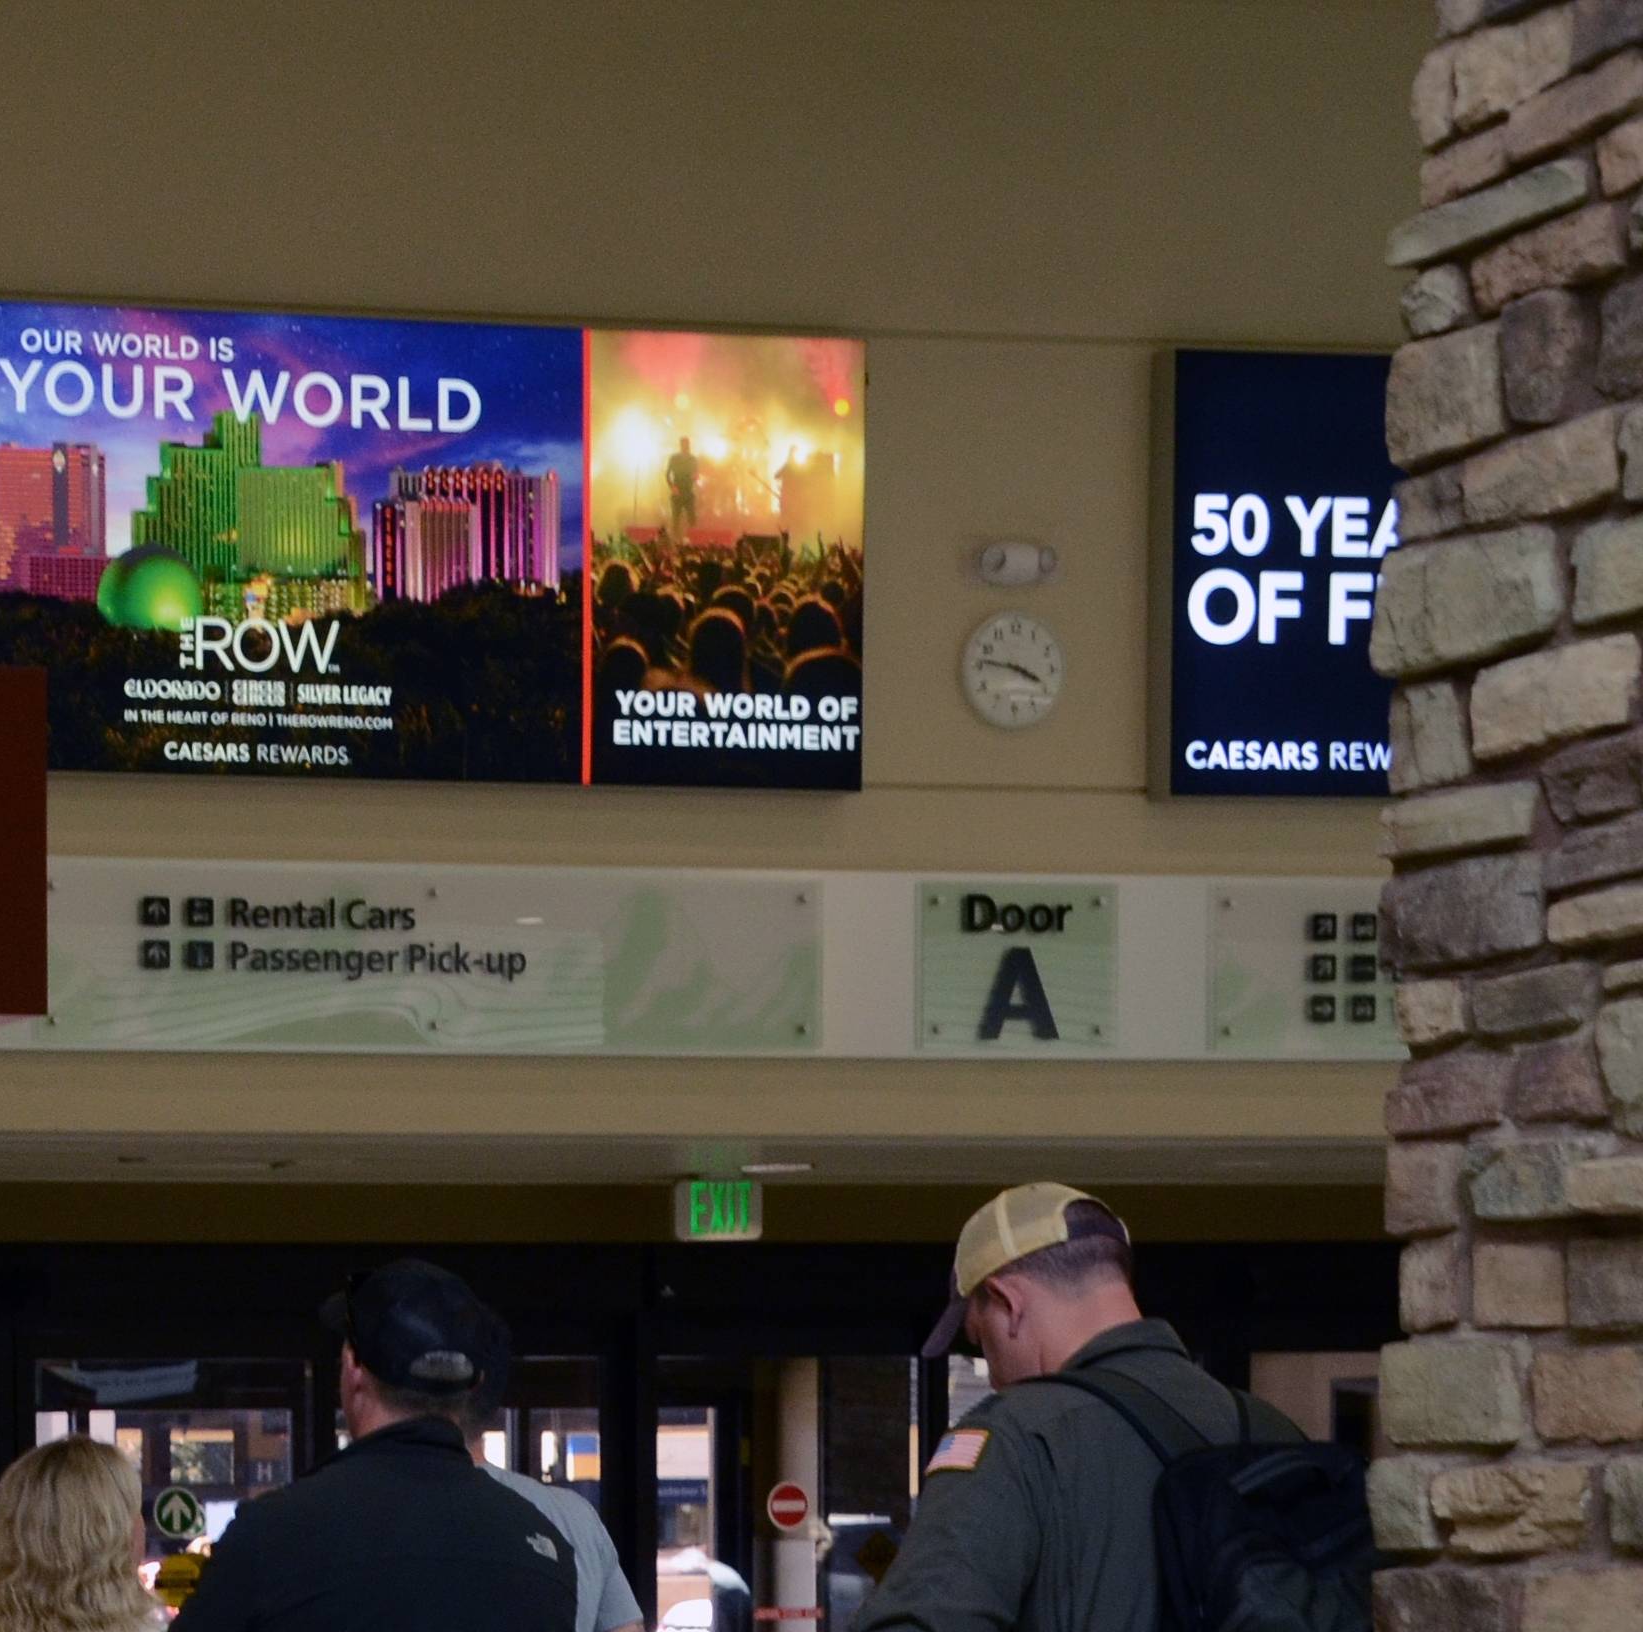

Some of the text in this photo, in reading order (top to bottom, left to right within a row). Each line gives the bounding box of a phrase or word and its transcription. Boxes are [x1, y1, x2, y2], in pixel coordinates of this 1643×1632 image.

[20, 328, 234, 361] OUR WORLD IS
[223, 370, 482, 433] WORLD
[1191, 492, 1400, 558] 50 YEA
[1187, 568, 1304, 645] OF
[179, 615, 194, 670] THE
[195, 616, 340, 673] ROW
[124, 679, 221, 701] ELDORADO
[297, 684, 393, 706] SILVER LEGACY
[616, 690, 857, 722] YOUR WORLD OF
[124, 709, 393, 730] IN THE HEART OF RENO THEROWRENO.COM
[613, 719, 860, 751] ENTERTAINMENT
[164, 741, 349, 765] CAESARS REWARDS
[1185, 740, 1318, 770] CAESARS
[227, 897, 416, 930] Rental Cars
[961, 894, 1073, 934] Door
[228, 941, 526, 982] Passenger Pick-up
[977, 947, 1060, 1041] A
[689, 1181, 751, 1235] EXIT
